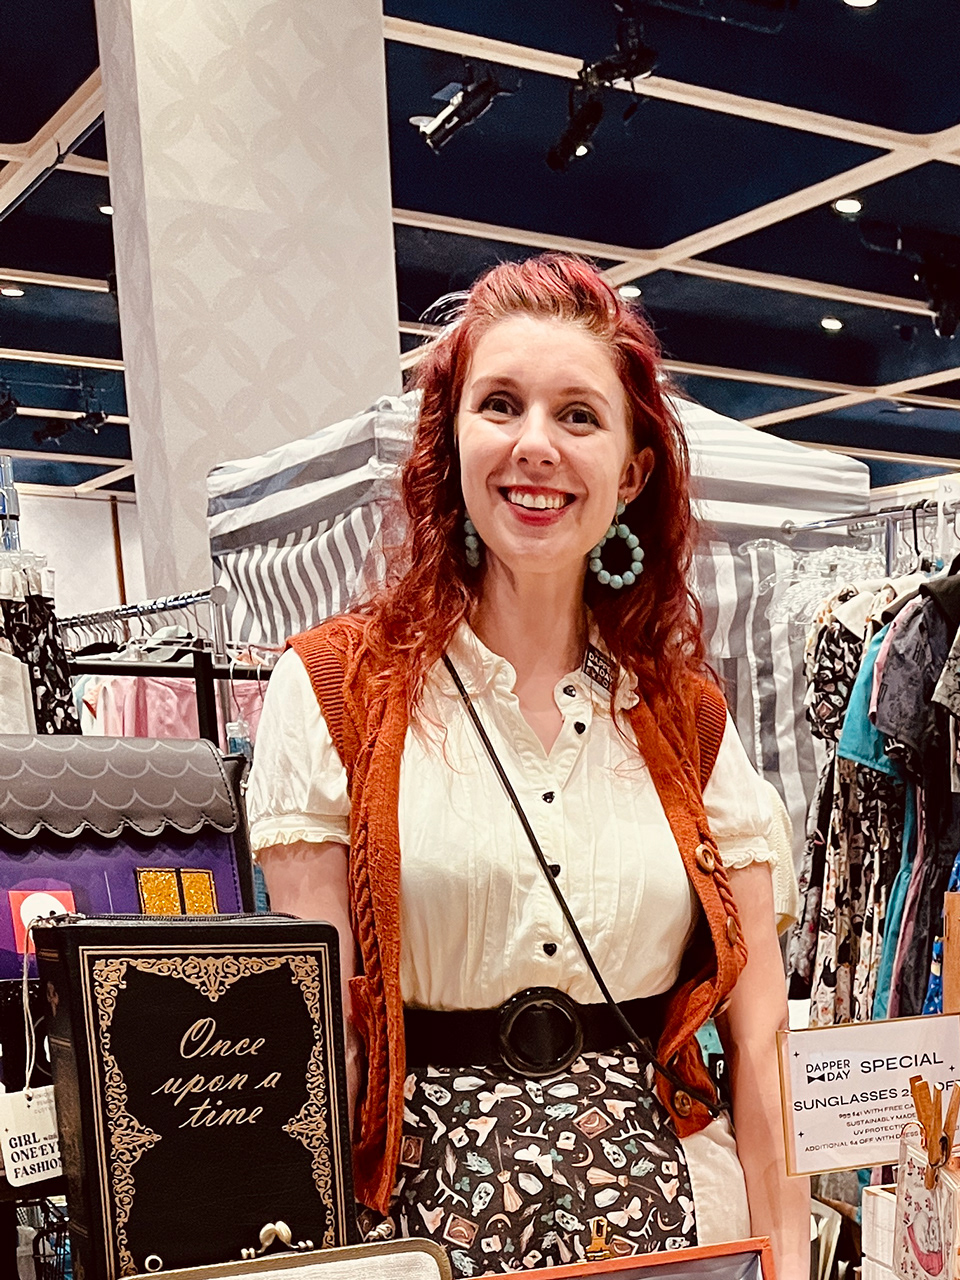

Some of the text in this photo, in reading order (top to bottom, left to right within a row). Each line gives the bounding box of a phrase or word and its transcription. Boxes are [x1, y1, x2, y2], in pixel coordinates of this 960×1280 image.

[180, 1017, 266, 1059] Once
[806, 1059, 850, 1073] DAPPER
[860, 1052, 943, 1074] SPECIAL
[827, 1070, 850, 1082] DAY
[151, 1072, 282, 1107] upon a
[794, 1089, 898, 1112] SUNGLASSES
[178, 1098, 264, 1129] time
[846, 1116, 894, 1127] SUSTAINABLY
[864, 1123, 909, 1134] PROTECTIO
[9, 1132, 41, 1149] GIRL
[805, 1141, 848, 1152] ADDITIONAL
[11, 1147, 38, 1163] ONE
